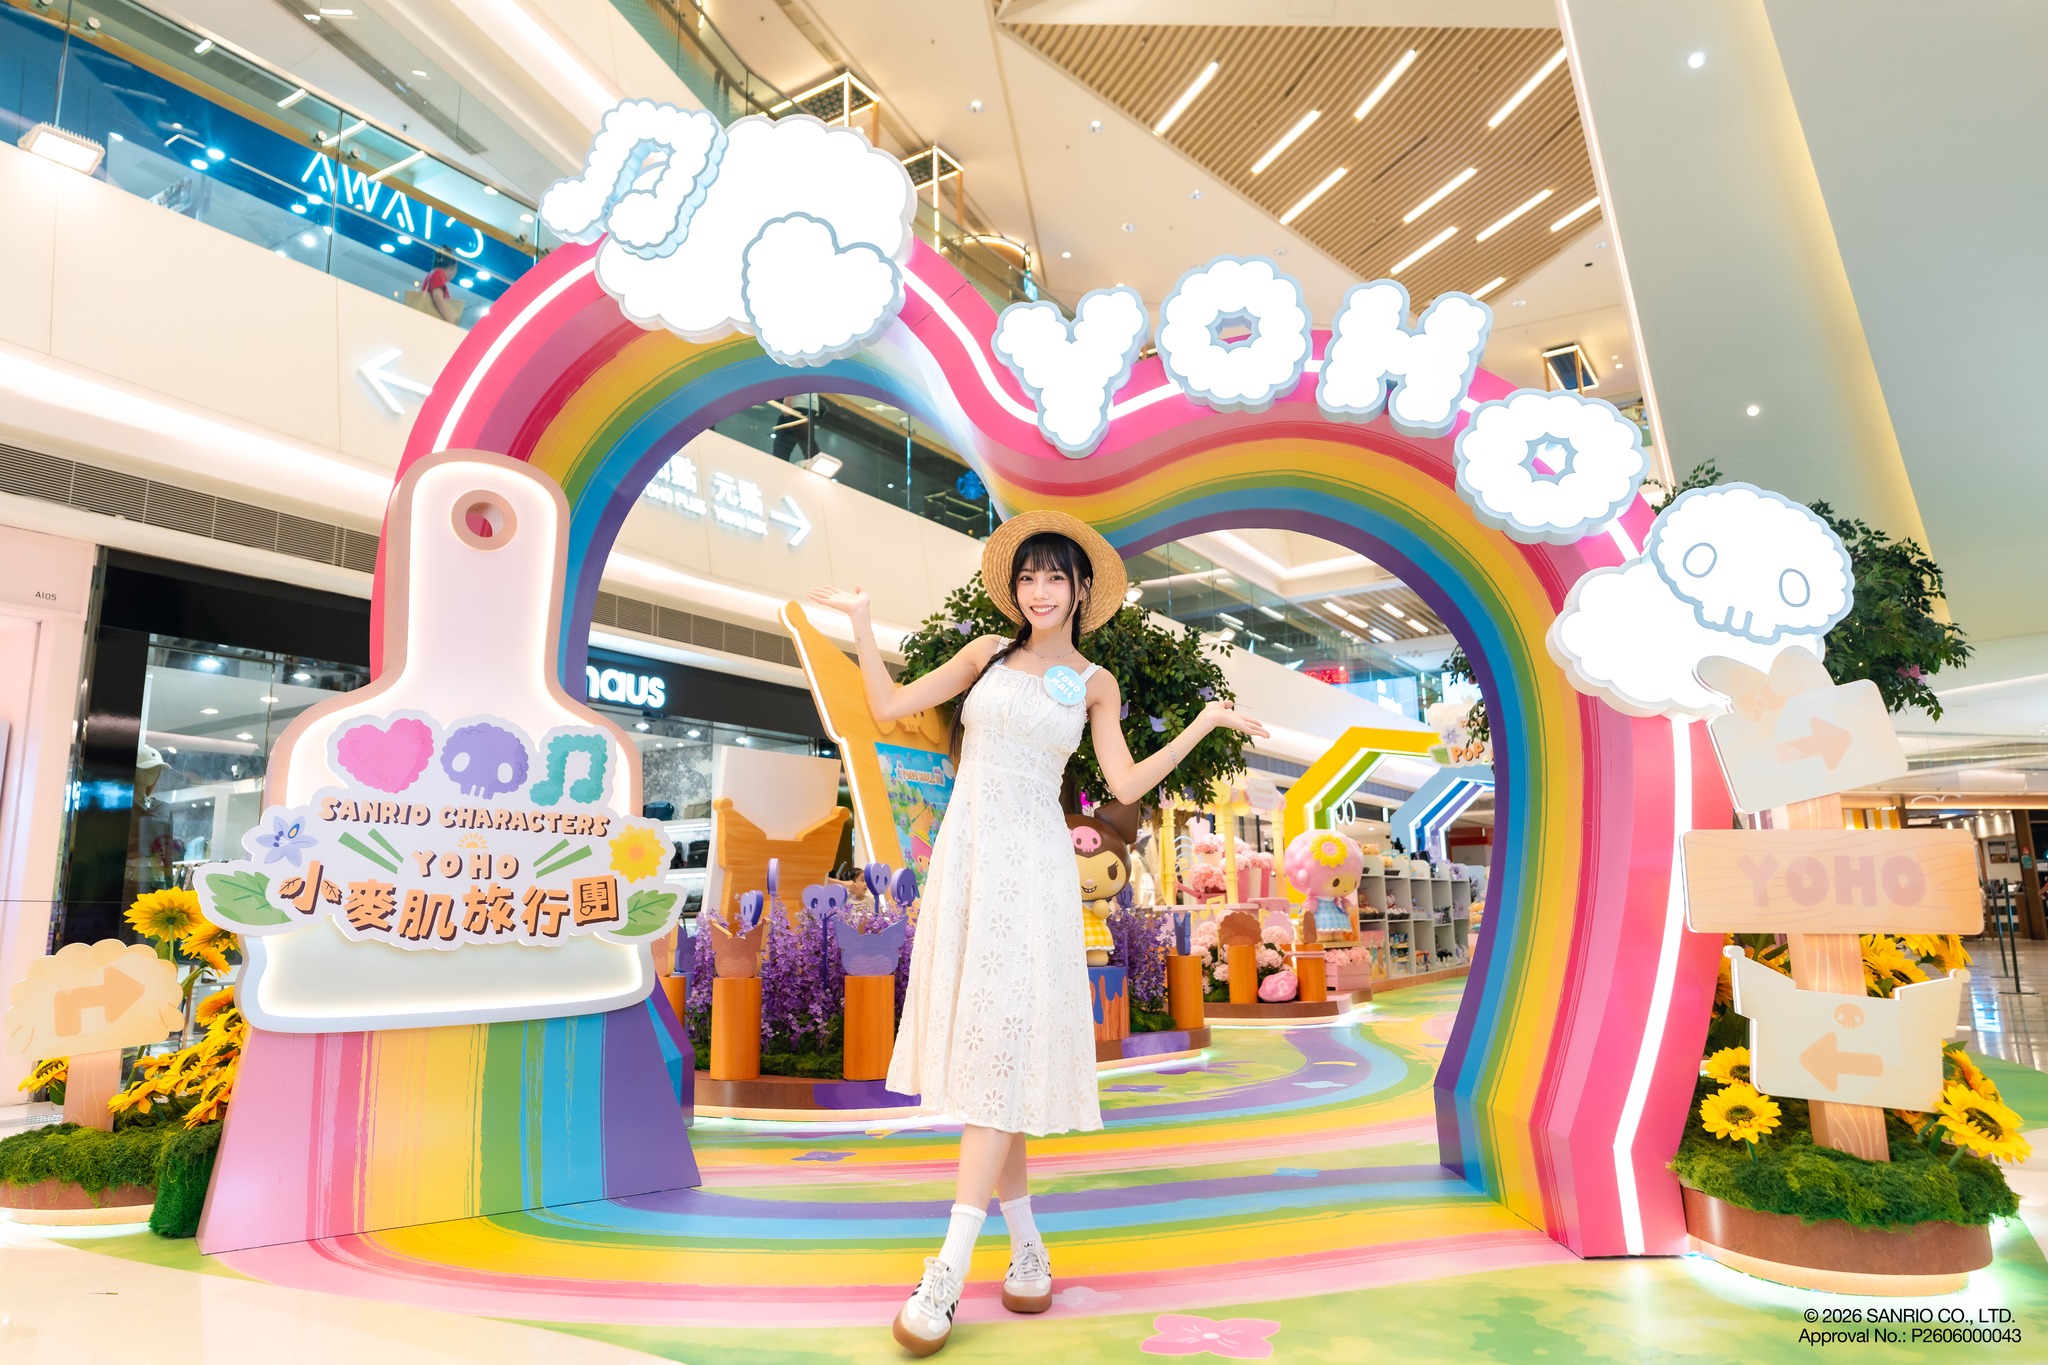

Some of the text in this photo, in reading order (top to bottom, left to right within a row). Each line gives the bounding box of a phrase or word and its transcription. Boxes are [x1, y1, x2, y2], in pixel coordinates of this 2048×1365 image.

[991, 253, 1651, 546] YOHO
[1050, 677, 1074, 699] MALL
[1056, 669, 1080, 693] YOHO
[1451, 741, 1485, 763] POP
[319, 796, 611, 838] SANRIO CHARACTERS
[412, 848, 520, 881] YOHO
[1736, 854, 1927, 907] YOHO
[278, 860, 620, 942] 小麥肌旅行團
